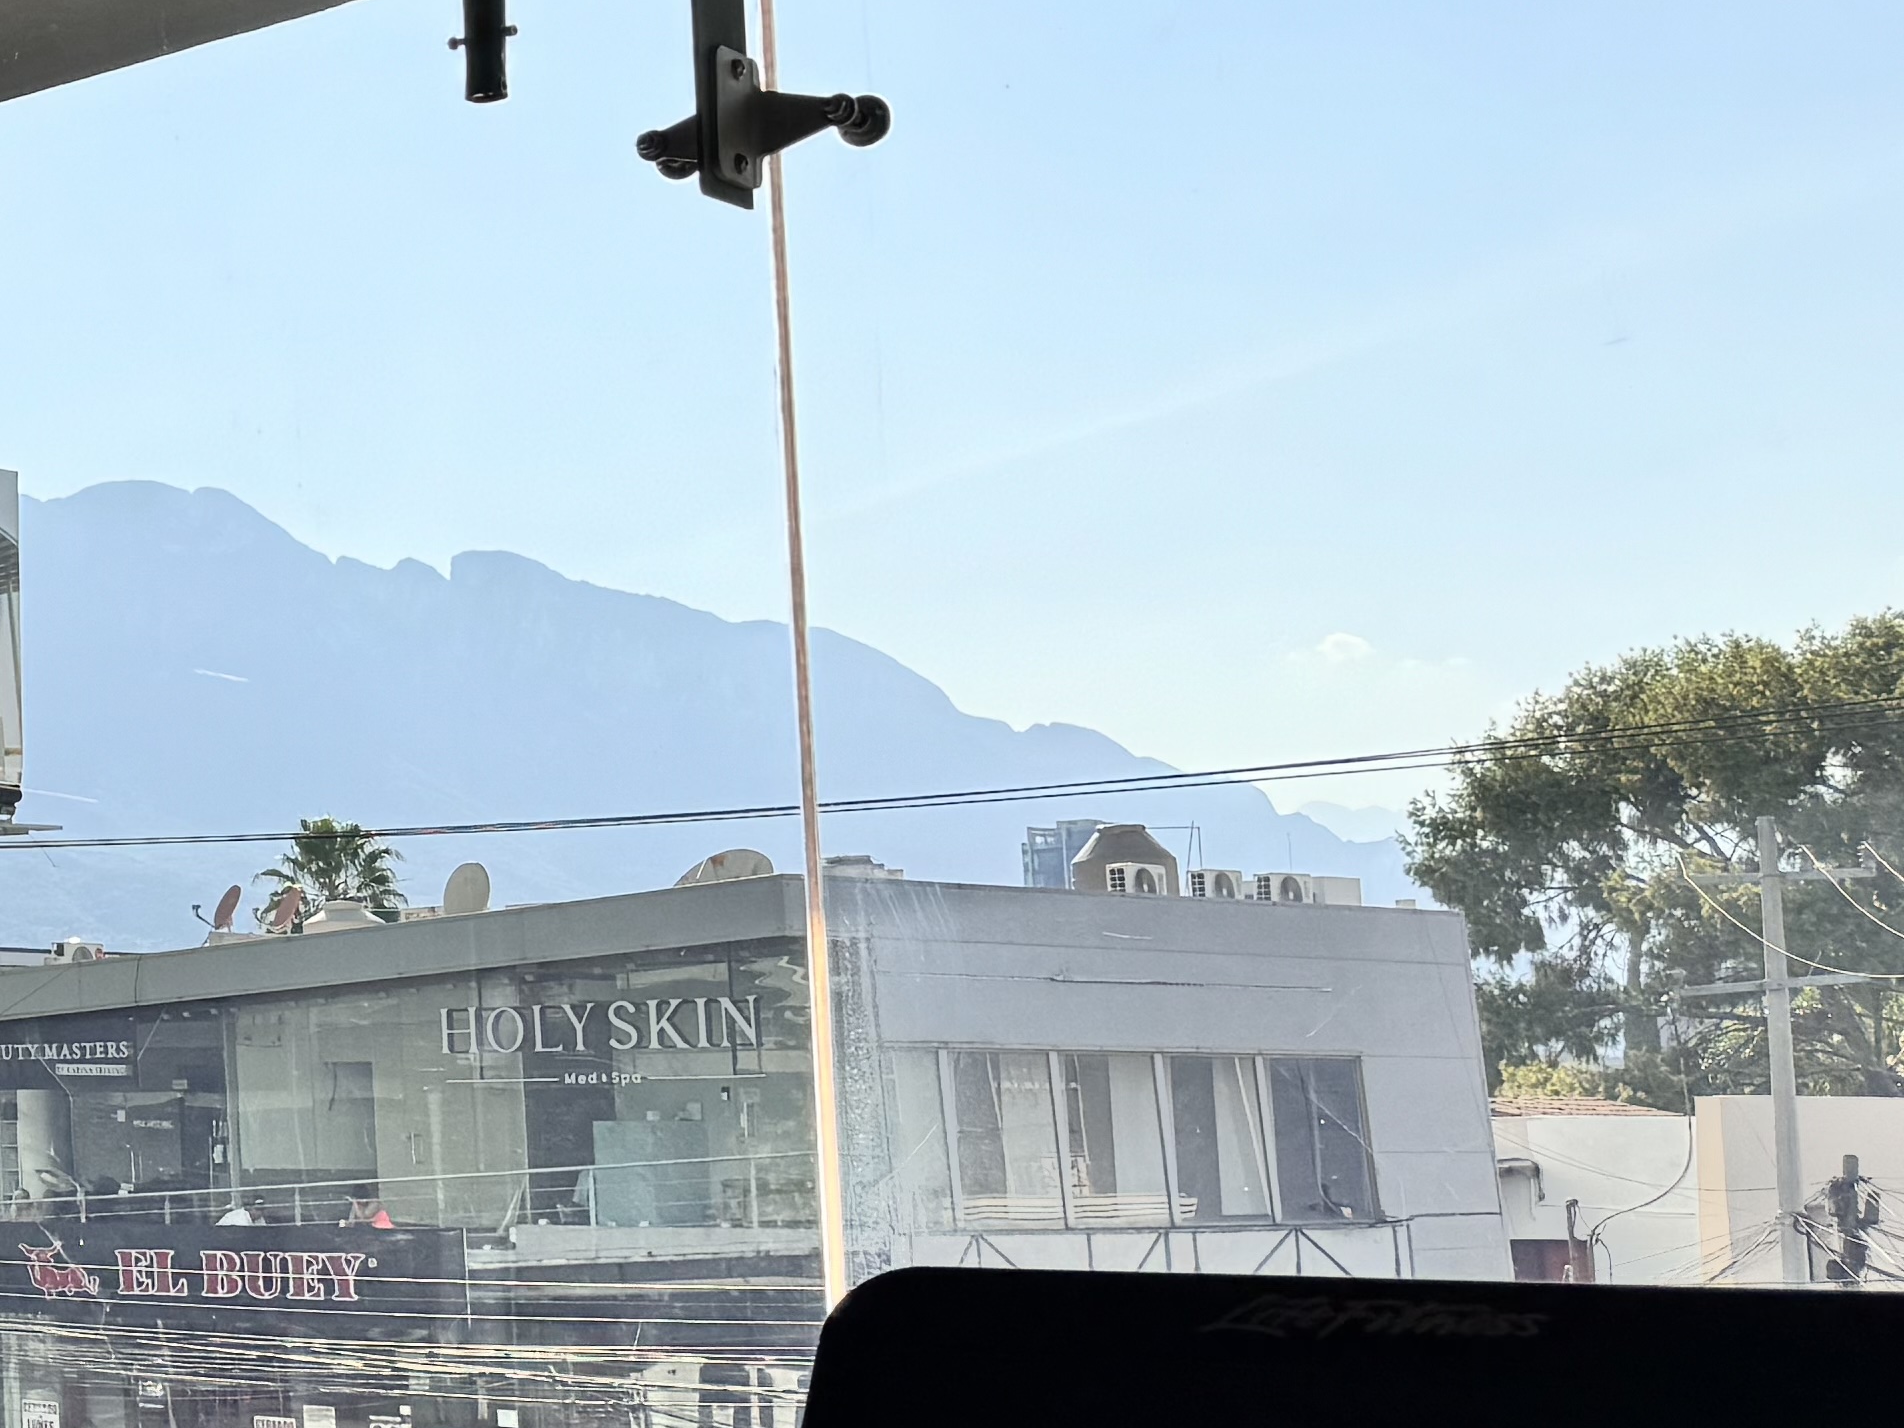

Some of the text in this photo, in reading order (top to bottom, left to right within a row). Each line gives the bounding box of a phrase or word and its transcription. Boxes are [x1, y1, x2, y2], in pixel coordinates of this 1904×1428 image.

[440, 995, 762, 1056] HOLY SKIN
[43, 1041, 129, 1060] MASTERS
[564, 1071, 642, 1087] Med Spa
[116, 1249, 366, 1302] EL BUEY
